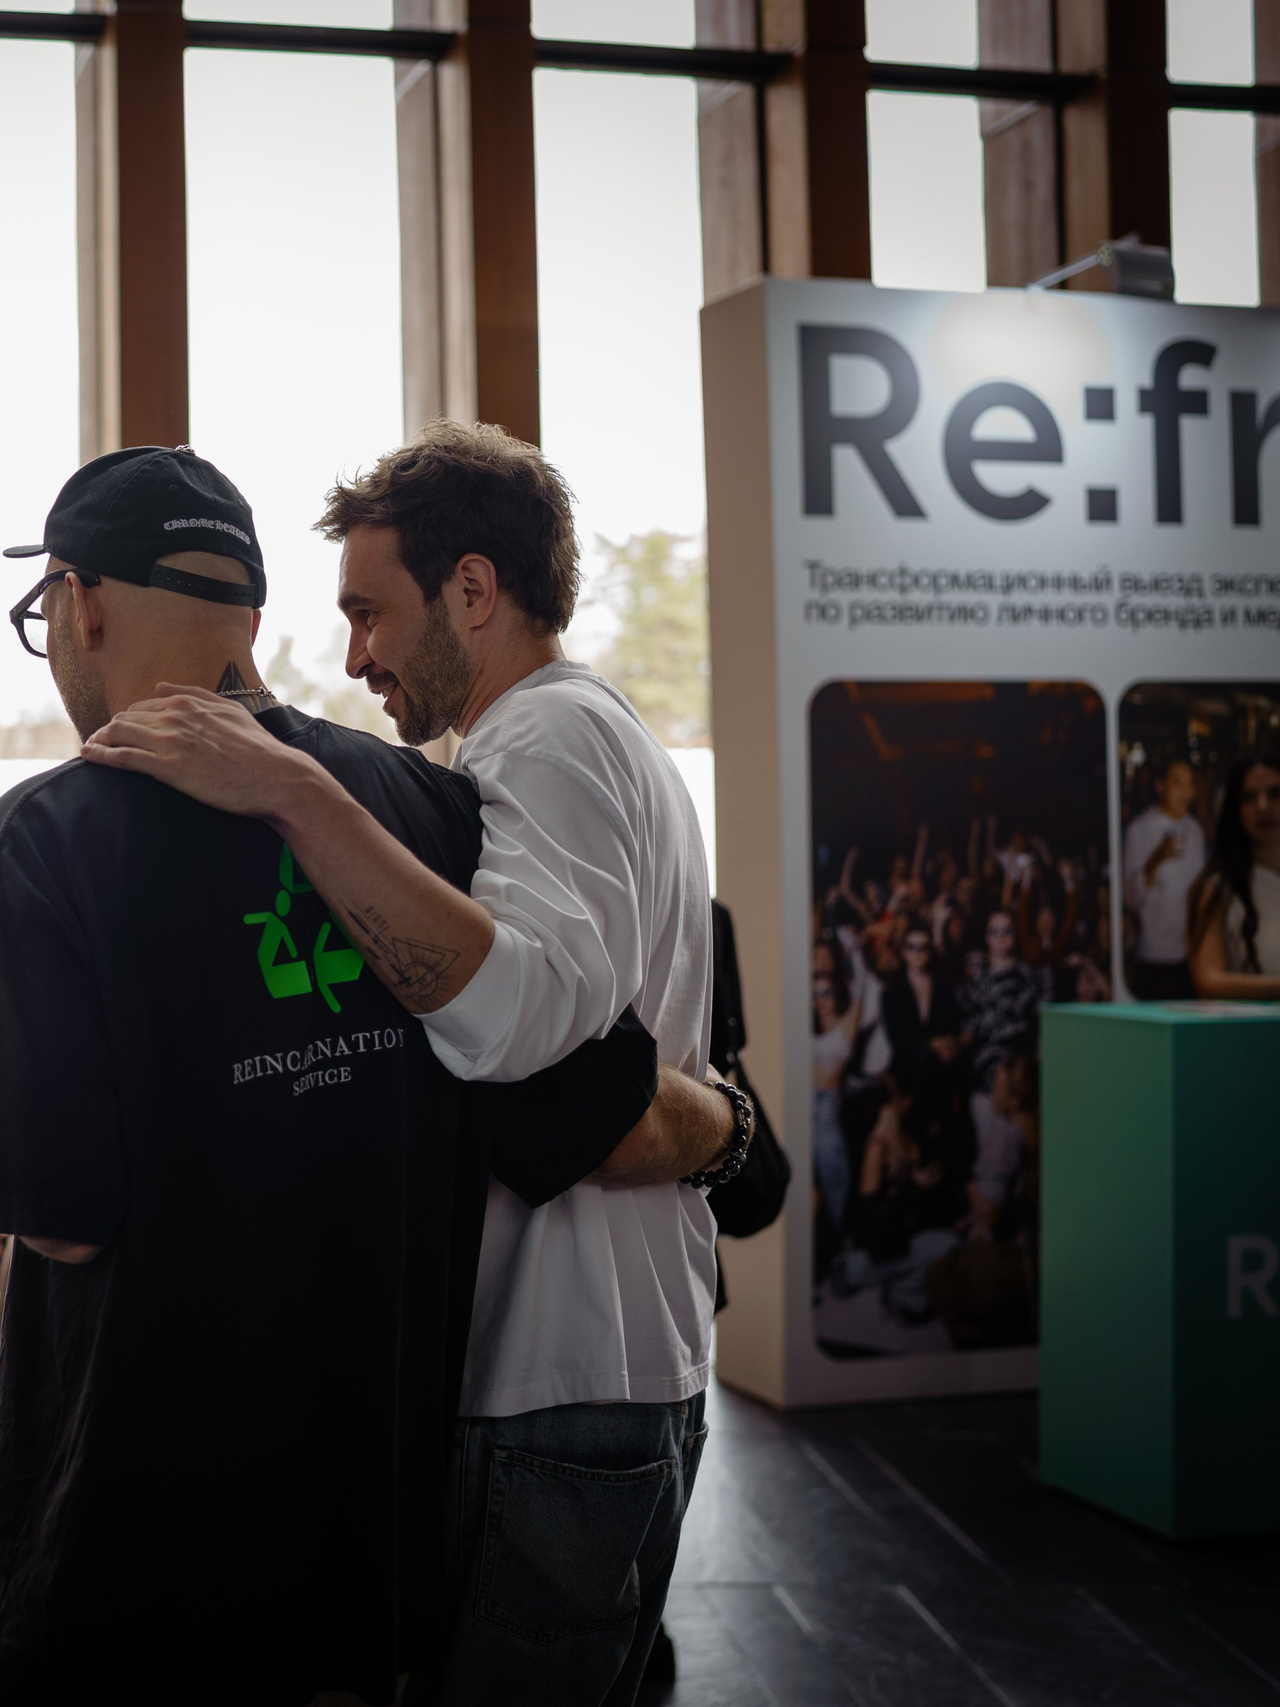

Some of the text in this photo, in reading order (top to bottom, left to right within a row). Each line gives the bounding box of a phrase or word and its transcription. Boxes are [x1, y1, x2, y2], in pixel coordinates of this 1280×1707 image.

[804, 560, 1112, 598] Трансформационный
[1119, 571, 1205, 600] выезд
[805, 601, 842, 623] по
[849, 602, 990, 630] развитию
[997, 602, 1109, 626] личного
[1115, 596, 1215, 632] бренда
[1220, 605, 1238, 627] и
[293, 1067, 352, 1096] SERVICE
